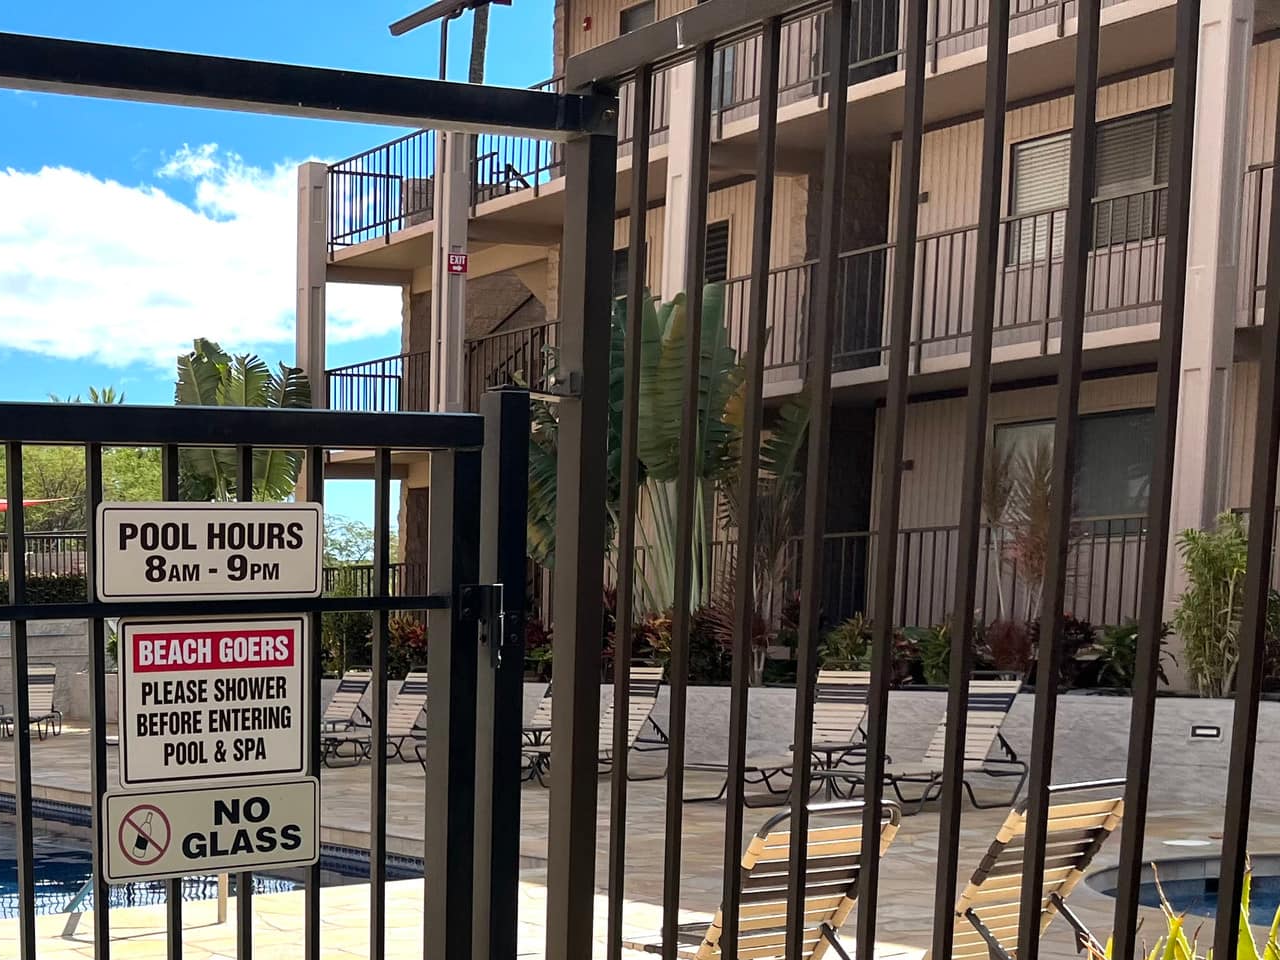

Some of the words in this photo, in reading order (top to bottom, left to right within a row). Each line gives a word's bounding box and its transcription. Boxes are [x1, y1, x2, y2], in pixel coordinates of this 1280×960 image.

[450, 255, 466, 264] EXIT
[119, 522, 197, 550] POOL
[207, 522, 304, 549] HOURS
[145, 555, 200, 582] 8AM
[227, 554, 280, 581] 9PM
[138, 638, 212, 666] BEACH
[220, 635, 289, 662] GOERS
[141, 679, 208, 706] PLEASE
[214, 675, 287, 702] SHOWER
[137, 710, 203, 737] BEFORE
[208, 705, 292, 733] ENTERING
[164, 740, 208, 766] POOL
[214, 740, 227, 763] &
[233, 737, 266, 762] SPA
[214, 796, 271, 826] NO
[181, 824, 302, 859] GLASS
